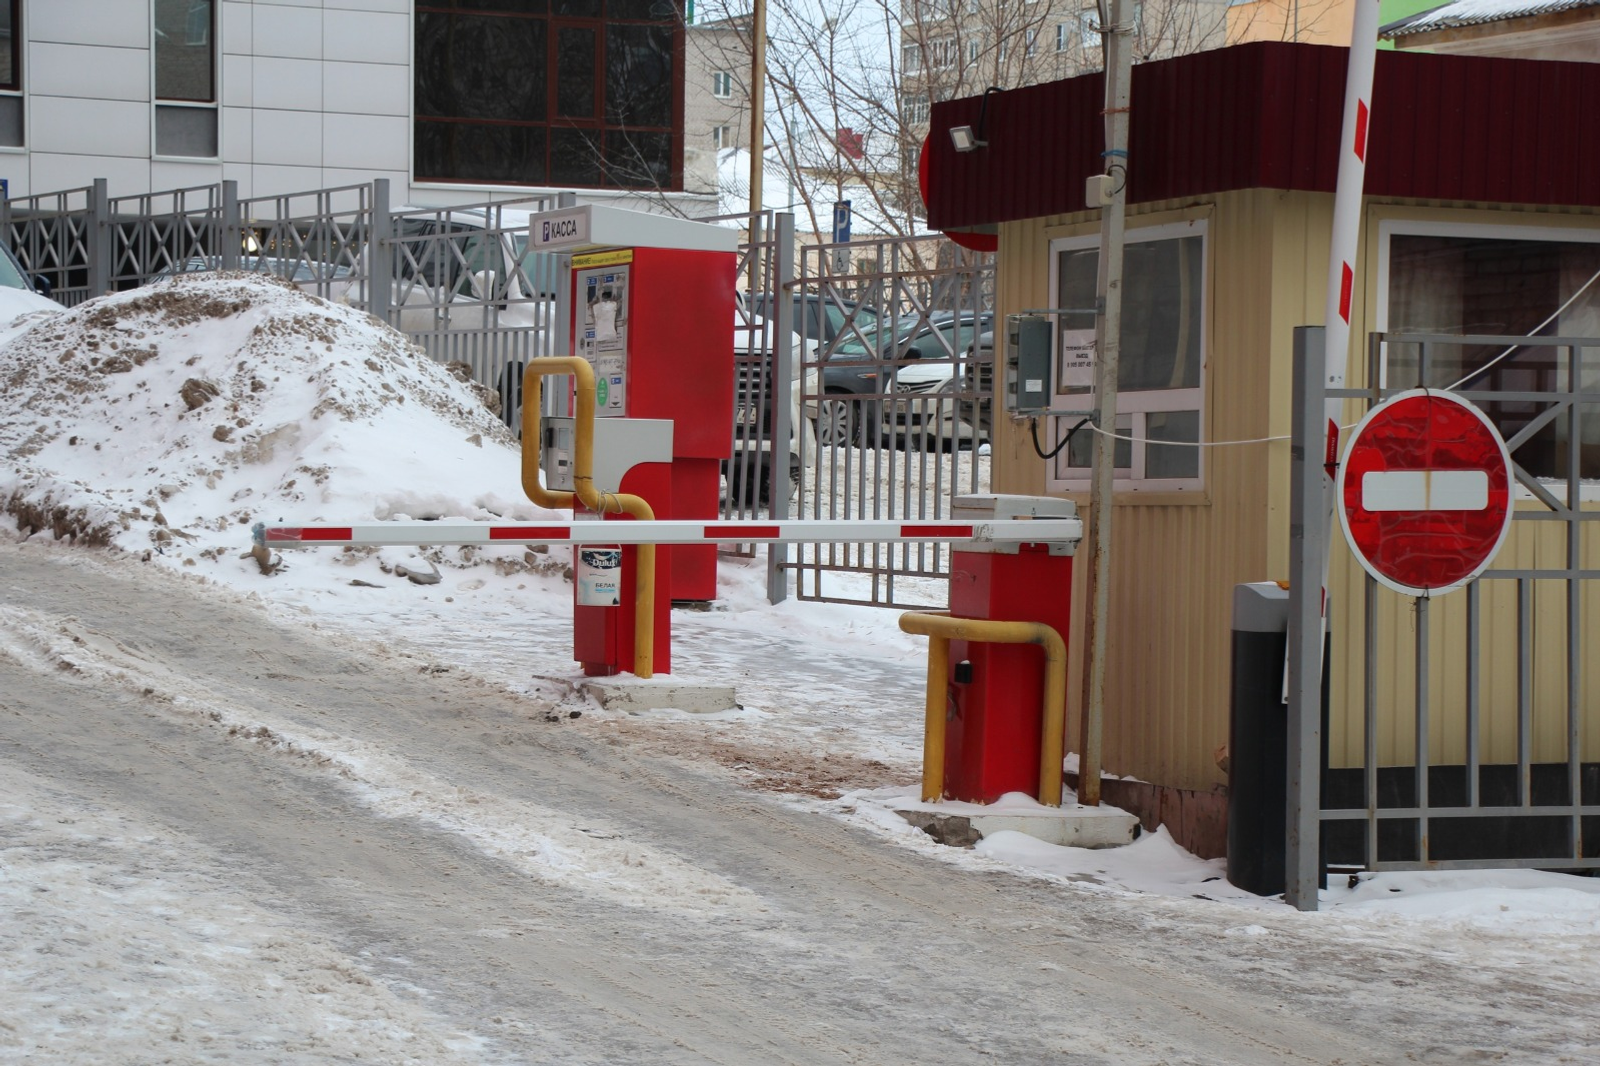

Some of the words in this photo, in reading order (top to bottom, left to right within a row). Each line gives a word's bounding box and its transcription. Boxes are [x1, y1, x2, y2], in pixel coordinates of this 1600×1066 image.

[551, 220, 577, 238] КАССА
[836, 208, 849, 243] P
[592, 558, 616, 566] Dulux
